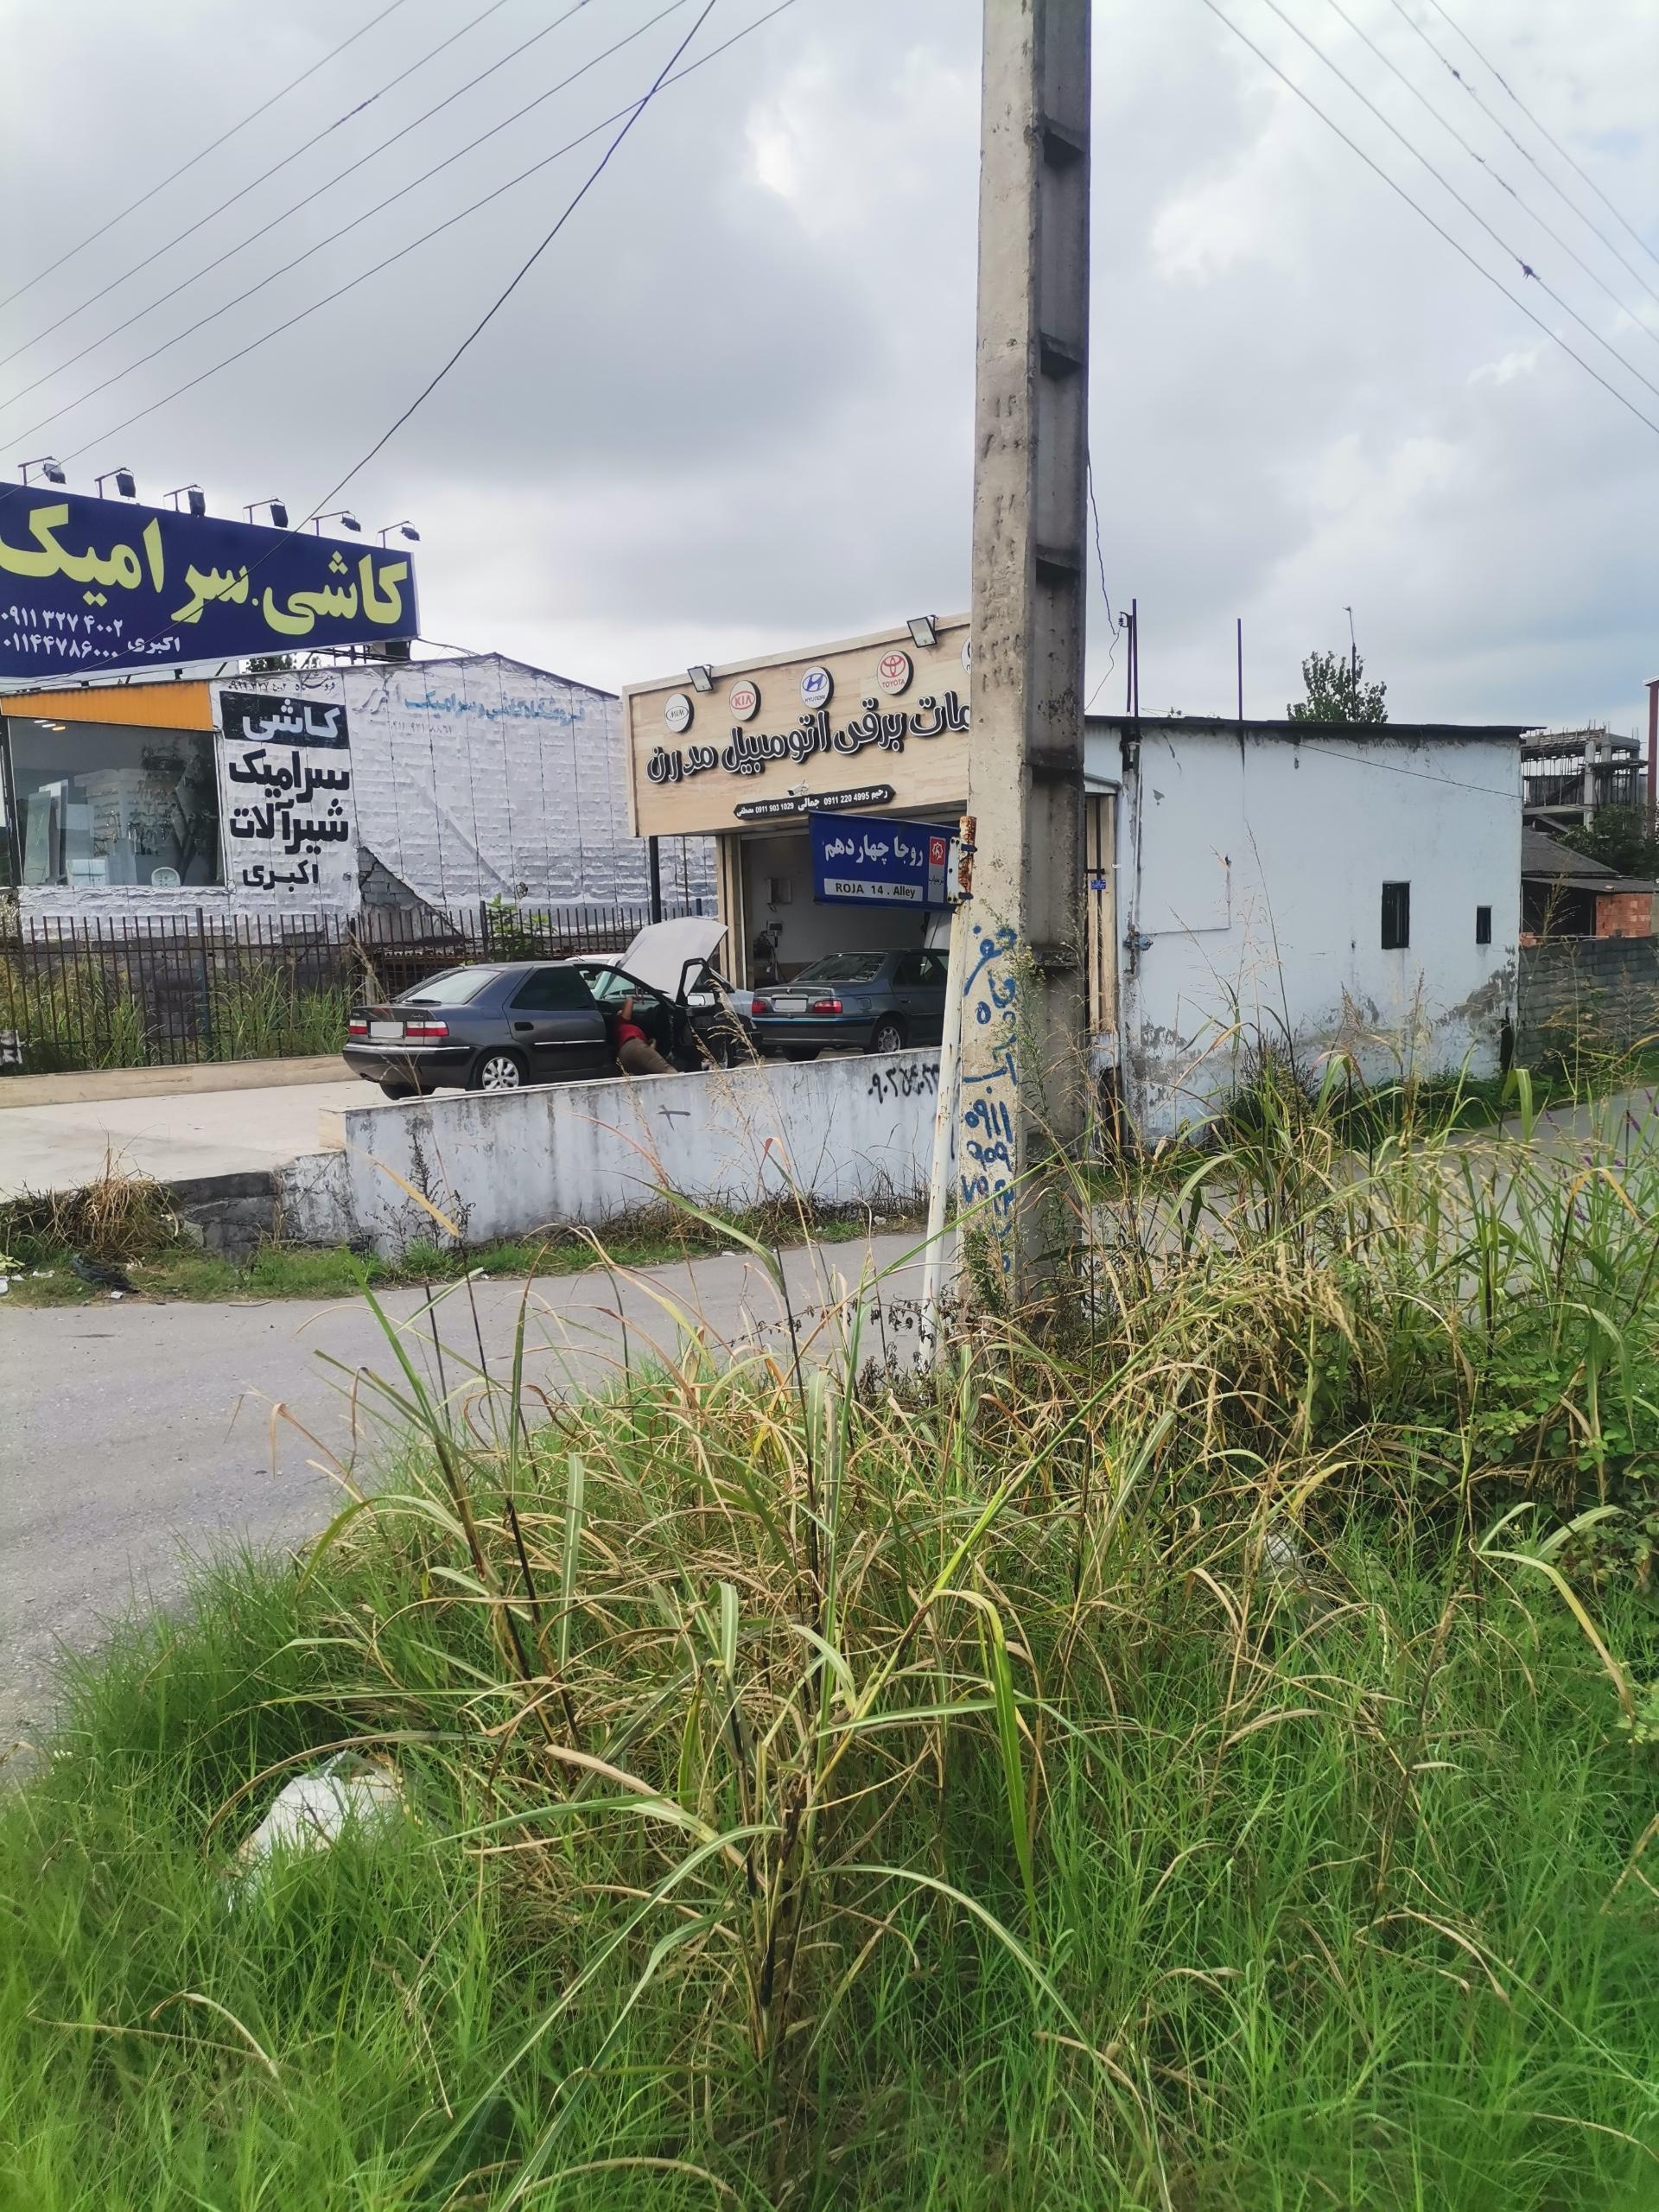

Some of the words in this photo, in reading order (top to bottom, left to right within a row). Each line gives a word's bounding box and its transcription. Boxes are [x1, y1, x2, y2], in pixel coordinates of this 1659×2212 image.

[1, 606, 36, 627] ۰۹۱۱
[42, 610, 79, 632] ۳۲۷
[83, 615, 123, 638] ۴۰۰۲
[128, 637, 181, 654] اکبری
[881, 679, 906, 689] TOYOTA
[734, 695, 753, 707] KIA
[804, 694, 826, 703] HYUNDAI
[242, 698, 340, 741] کاشی
[833, 697, 907, 754] برقی
[721, 709, 832, 774] اتومبیل
[647, 746, 719, 784] مدرن
[229, 748, 349, 803] سرامیک
[823, 796, 839, 805] 0911
[841, 794, 852, 804] 220
[853, 791, 869, 802] 4995
[871, 788, 888, 801] رحیم
[755, 804, 768, 813] 0911
[780, 802, 794, 810] 1029
[798, 797, 820, 811] جمالی
[893, 836, 923, 866] روجا
[243, 860, 319, 893] اکبری
[836, 882, 864, 894] ROJA
[871, 885, 883, 895] 14
[893, 886, 916, 899] Alley
